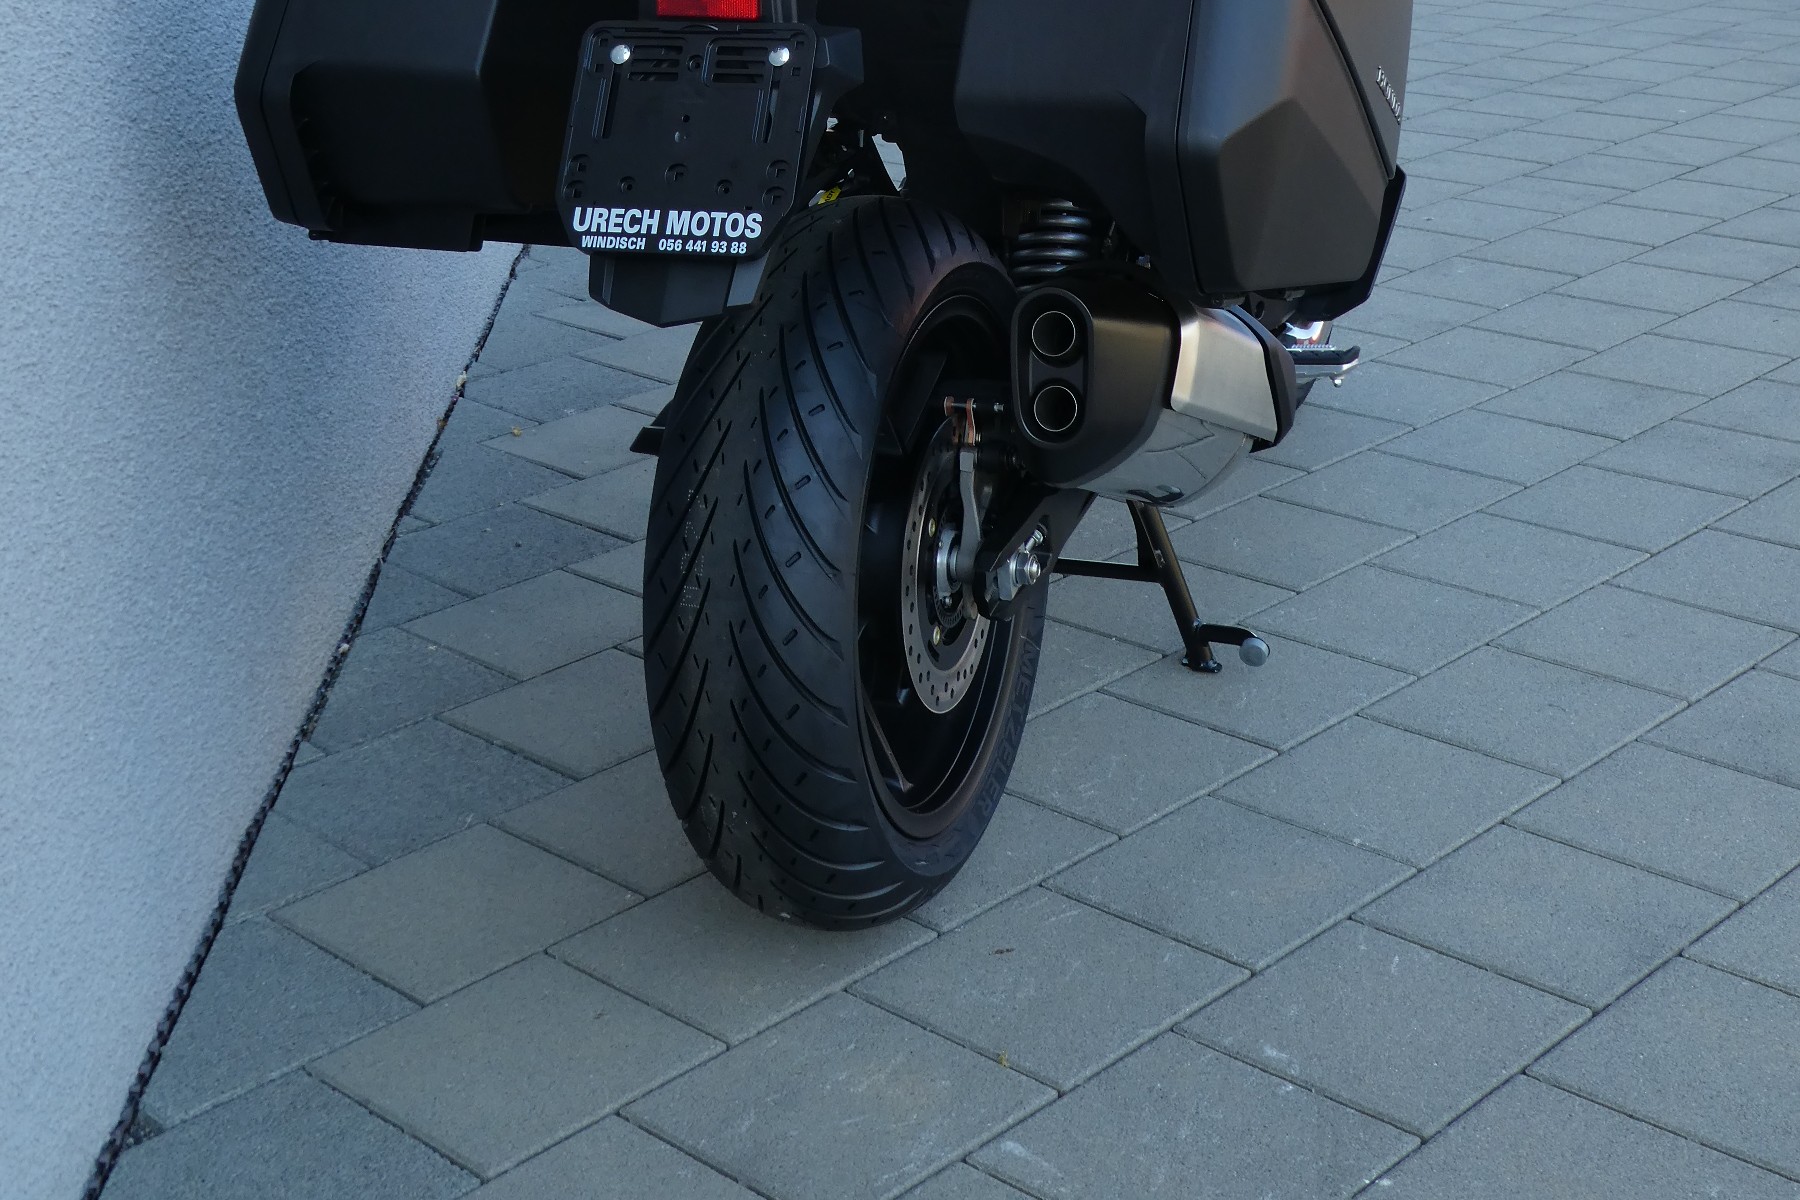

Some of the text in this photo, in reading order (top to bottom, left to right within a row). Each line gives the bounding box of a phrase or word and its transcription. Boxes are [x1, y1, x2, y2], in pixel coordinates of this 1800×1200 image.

[572, 206, 763, 239] URECH MOTOS
[581, 235, 747, 254] WINDISCH 056 441 93 88
